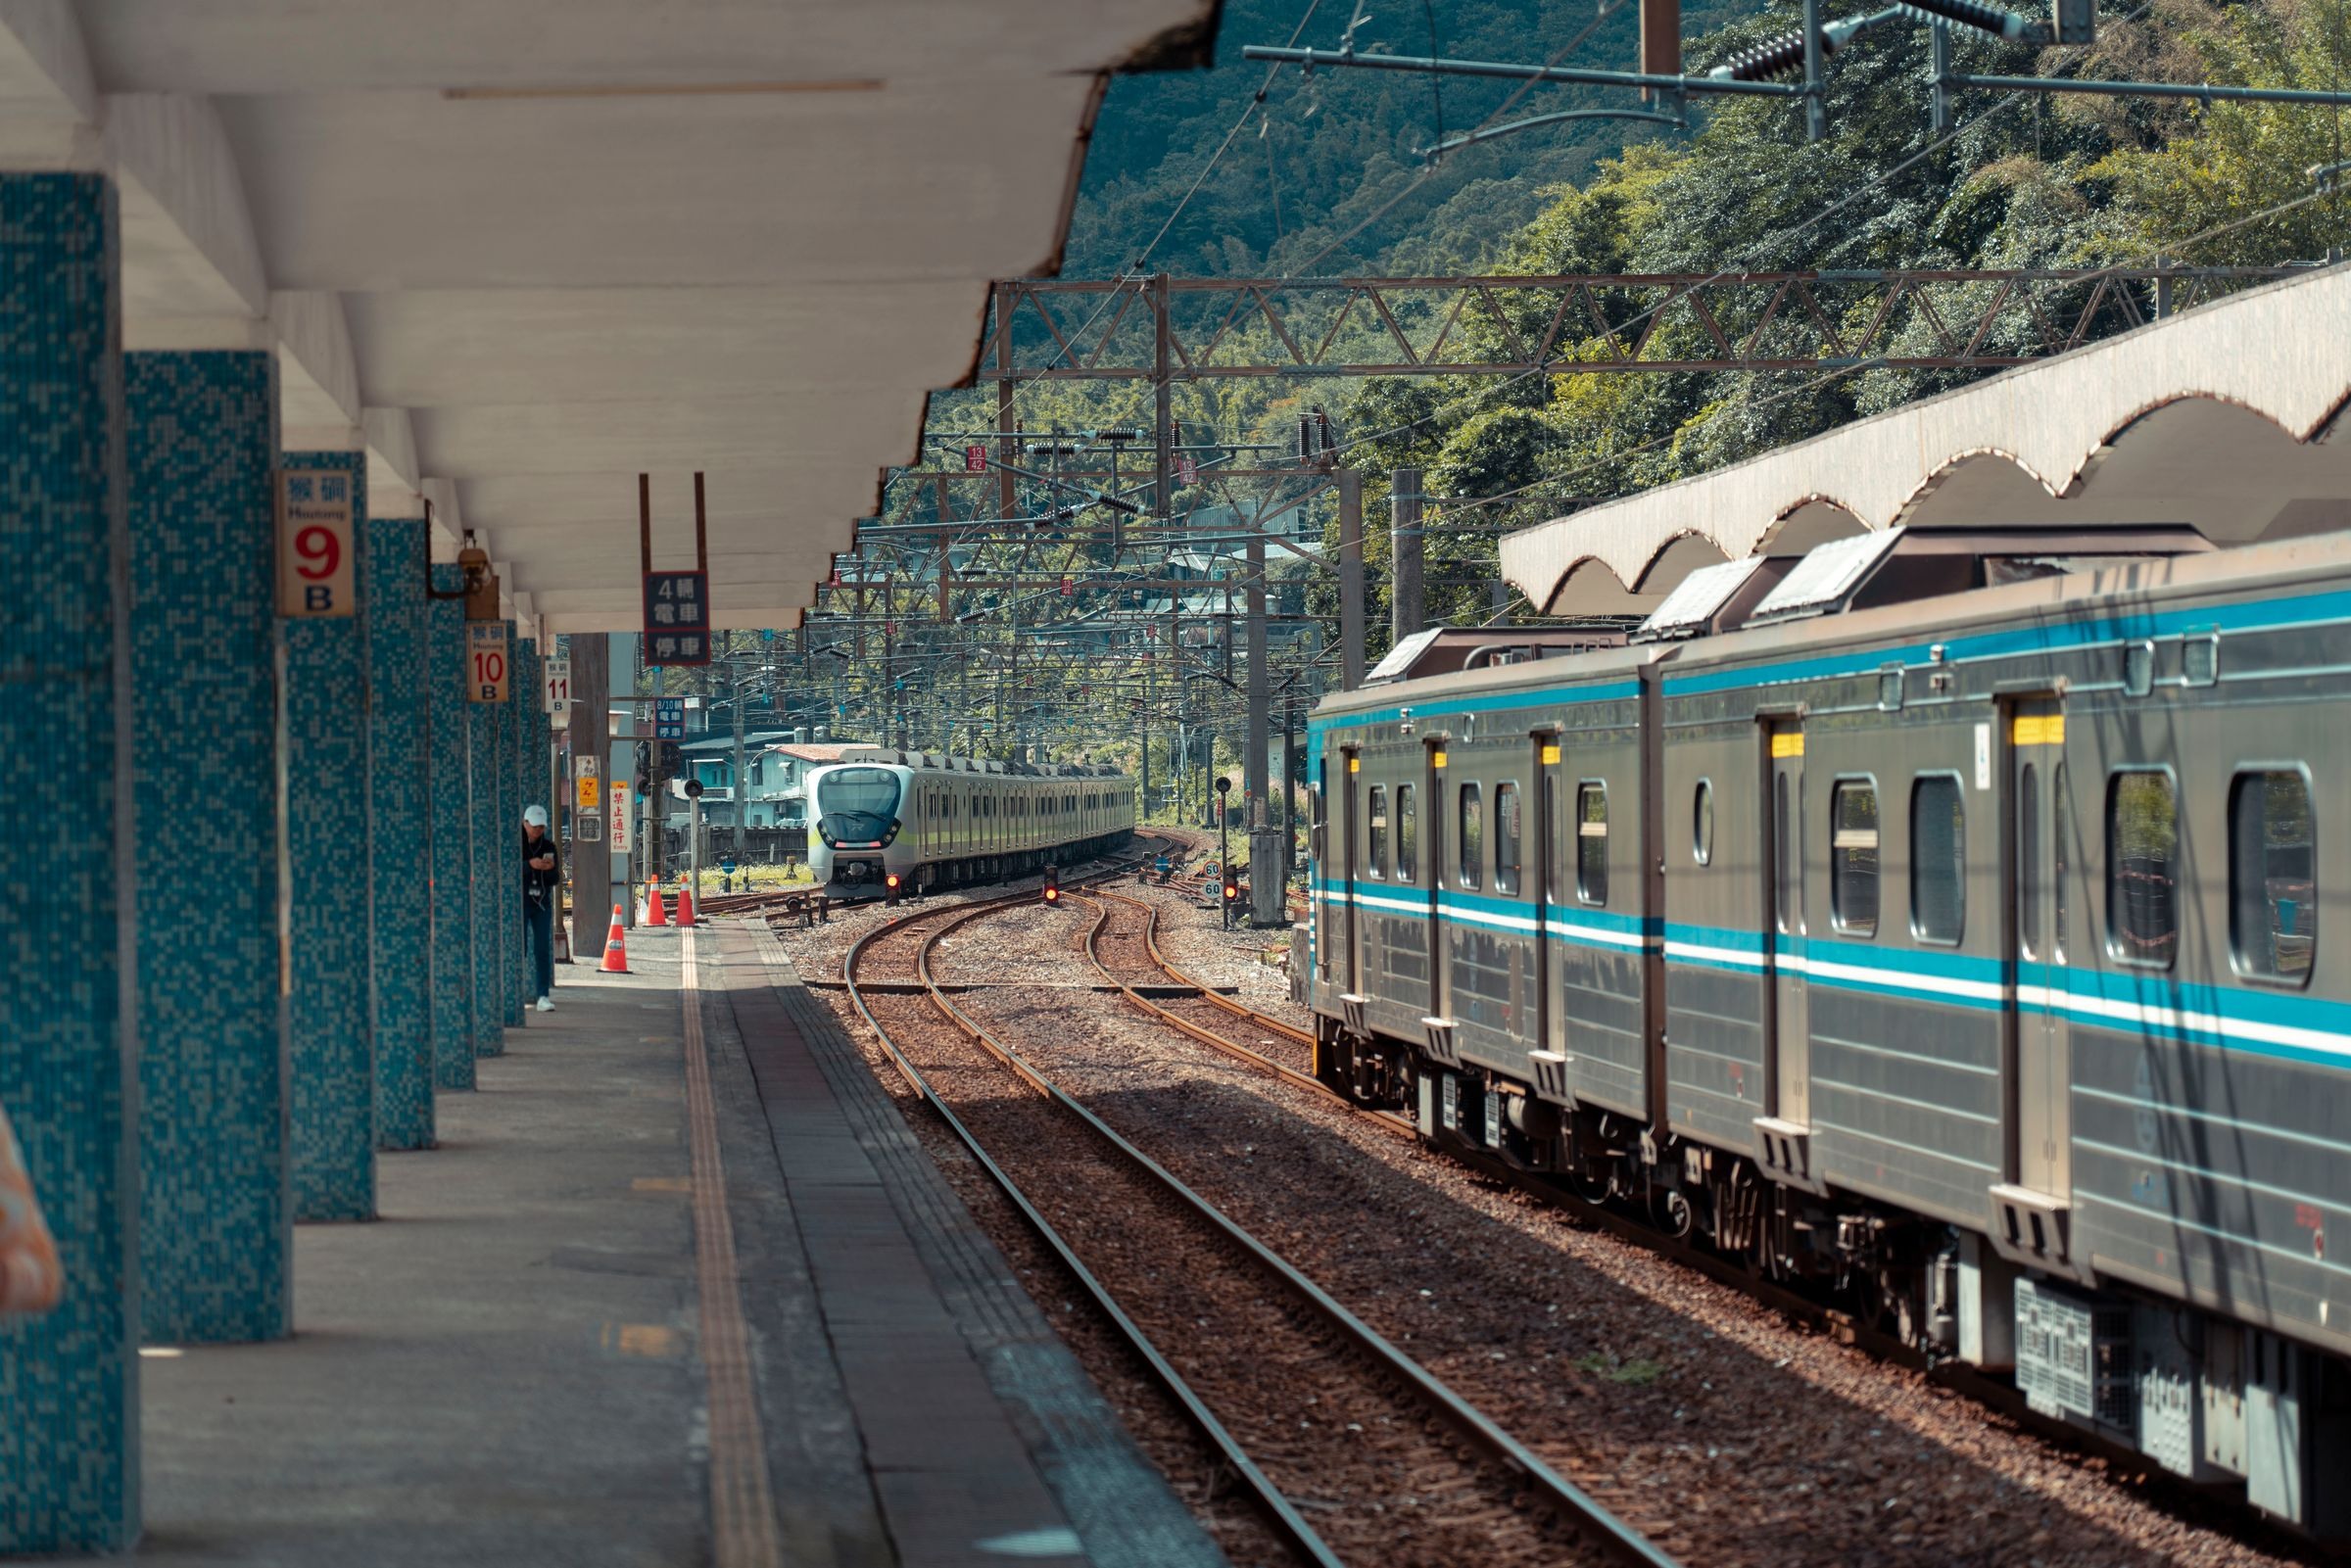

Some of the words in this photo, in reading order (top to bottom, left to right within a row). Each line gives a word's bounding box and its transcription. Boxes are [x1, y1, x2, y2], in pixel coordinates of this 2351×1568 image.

[972, 447, 983, 457] 13
[971, 459, 983, 470] 42
[1182, 460, 1193, 471] 13
[295, 524, 341, 580] 9
[305, 585, 333, 612] B
[474, 652, 504, 683] 10
[482, 686, 497, 699] B
[549, 678, 567, 699] 11
[553, 702, 563, 711] B
[613, 791, 625, 843] 禁止通行
[1206, 864, 1219, 875] 60
[1206, 884, 1220, 894] 60
